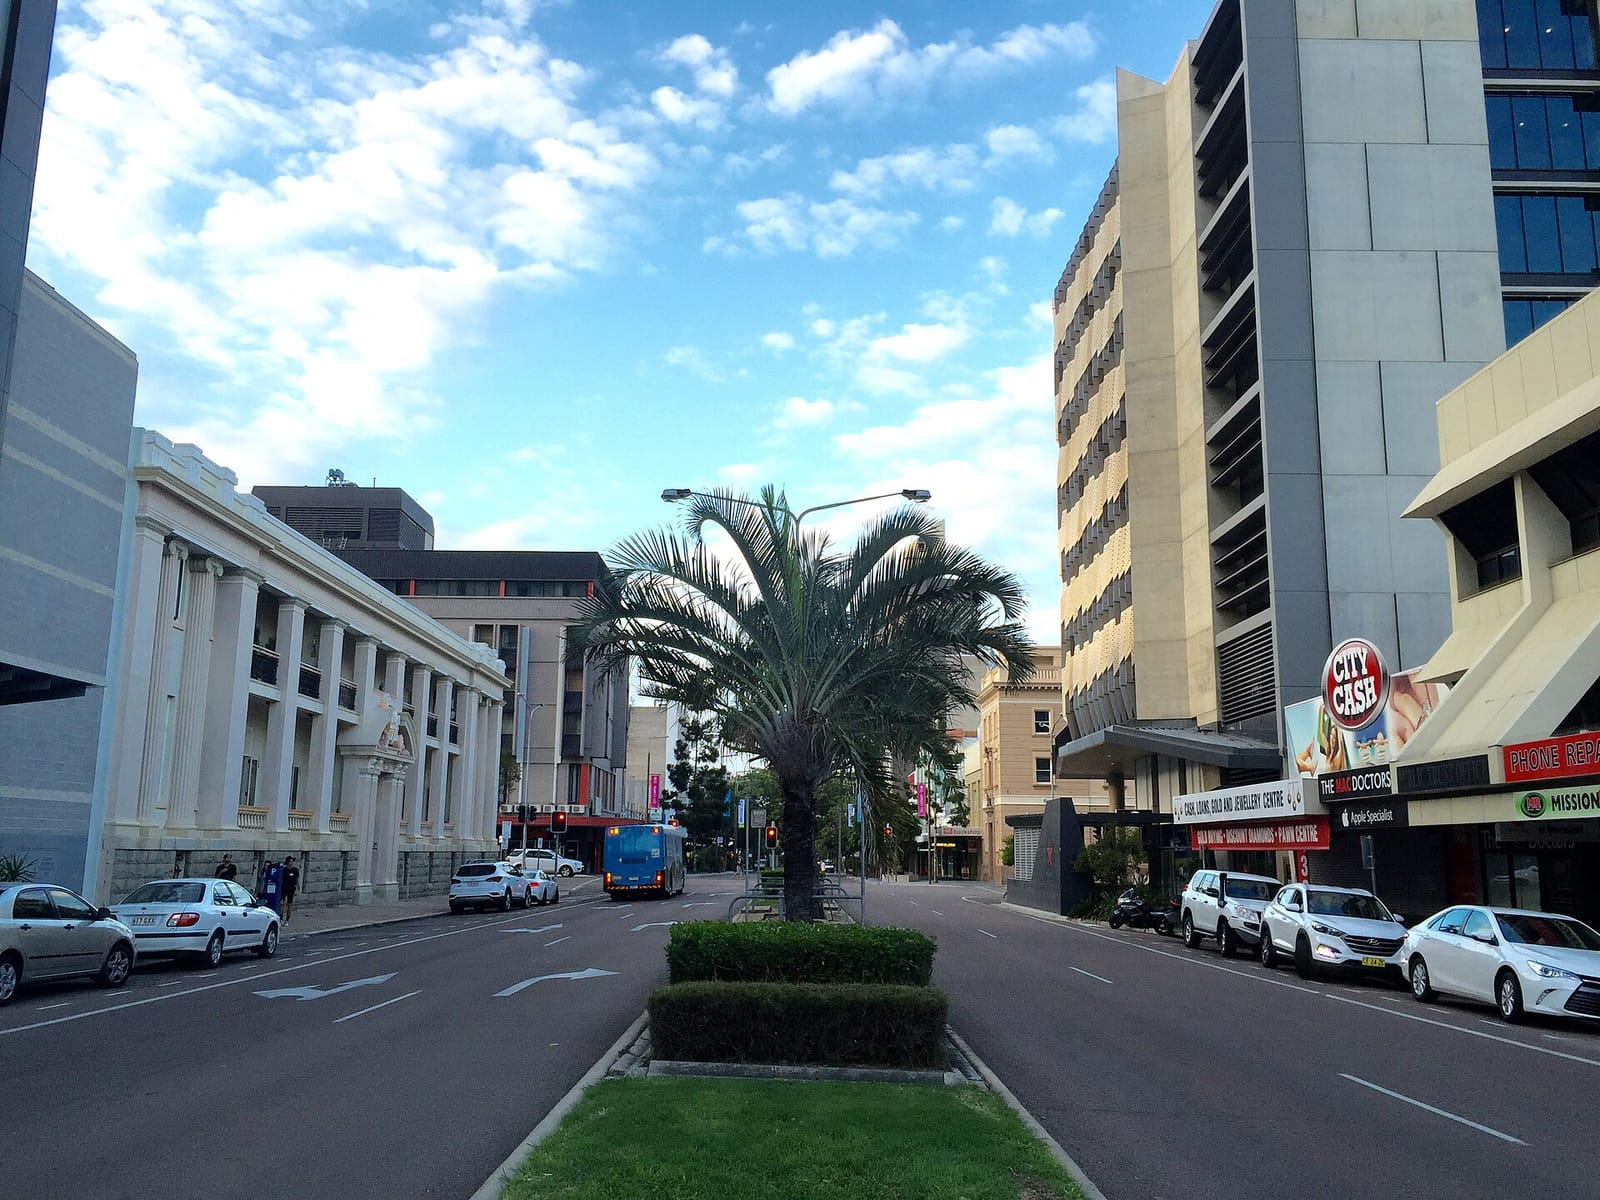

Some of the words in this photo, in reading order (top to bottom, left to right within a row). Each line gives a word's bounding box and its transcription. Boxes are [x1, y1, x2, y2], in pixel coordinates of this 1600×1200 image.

[1333, 647, 1368, 683] CITY
[1333, 676, 1378, 716] CASH
[1510, 745, 1560, 773] PHONE
[1321, 779, 1335, 795] THE
[1335, 776, 1351, 793] MAC
[1351, 771, 1392, 791] DOCTORS
[1184, 802, 1196, 817] CASH,
[1196, 799, 1211, 816] LOANS,
[1211, 798, 1223, 814] GOLD
[1223, 796, 1233, 812] AND
[1234, 793, 1261, 812] JEWELLERY
[1262, 790, 1284, 809] CENTRE
[1551, 791, 1600, 812] MISSION
[1350, 810, 1366, 826] Apple
[1366, 808, 1393, 825] Specialist
[1226, 828, 1248, 844] DISCOUNT
[1248, 826, 1275, 844] DIAMONDS
[1278, 826, 1295, 843] PAWN
[1295, 824, 1318, 843] CENTRE
[271, 868, 277, 876] P
